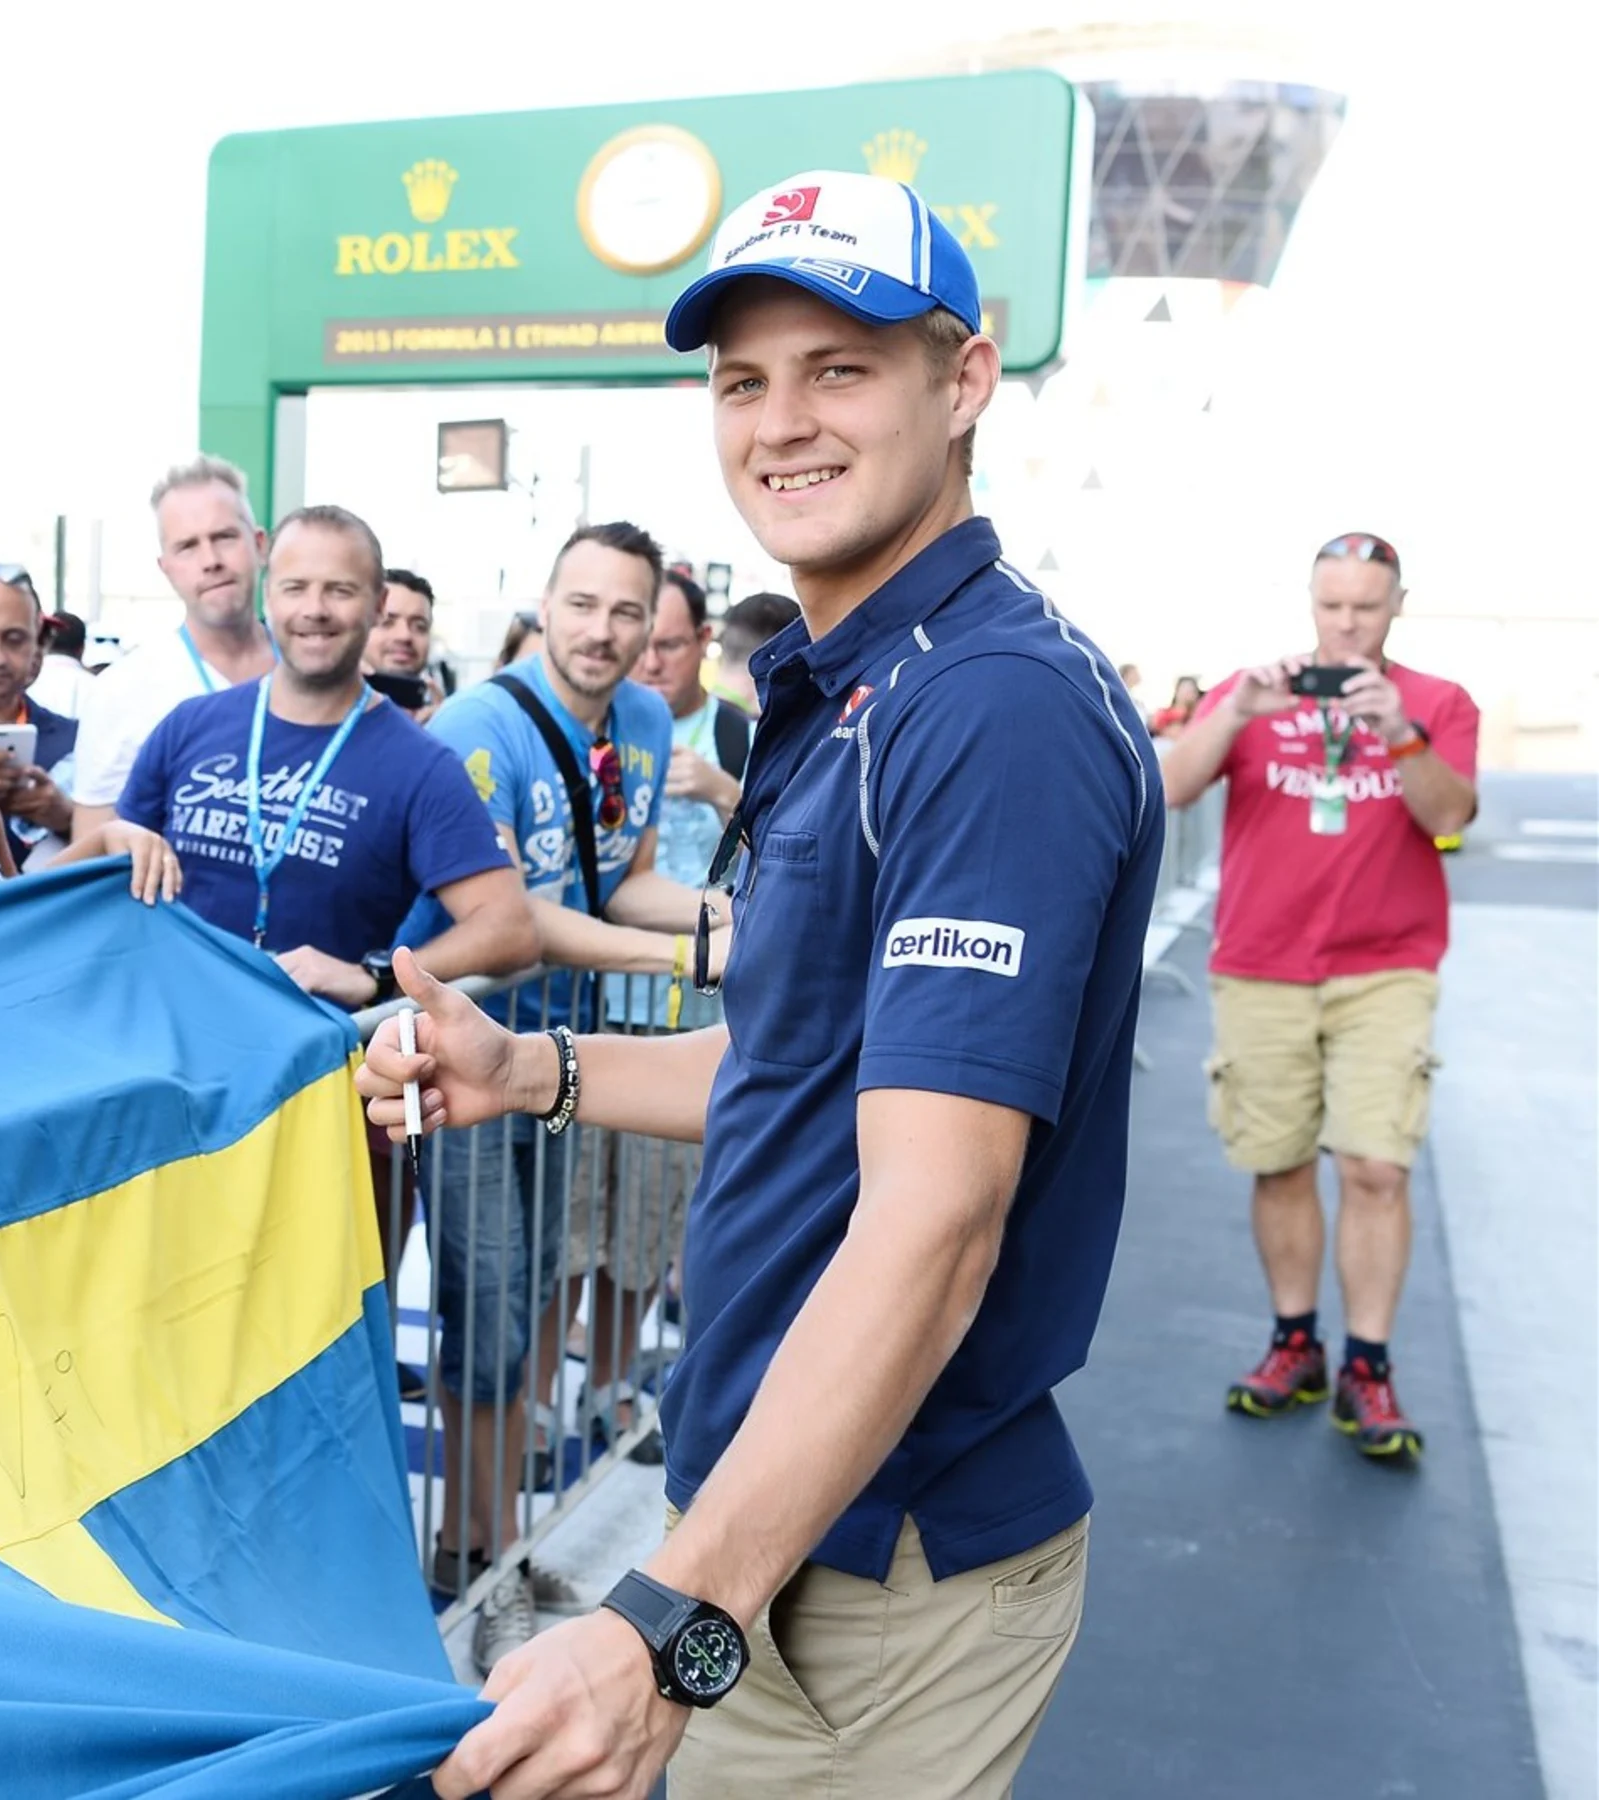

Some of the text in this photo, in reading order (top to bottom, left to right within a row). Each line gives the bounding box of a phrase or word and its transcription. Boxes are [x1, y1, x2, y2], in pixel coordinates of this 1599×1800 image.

[335, 227, 520, 275] ROLEX
[723, 222, 858, 264] Sauber F1 Team
[335, 329, 392, 353] 2015
[394, 326, 495, 351] FORMULA
